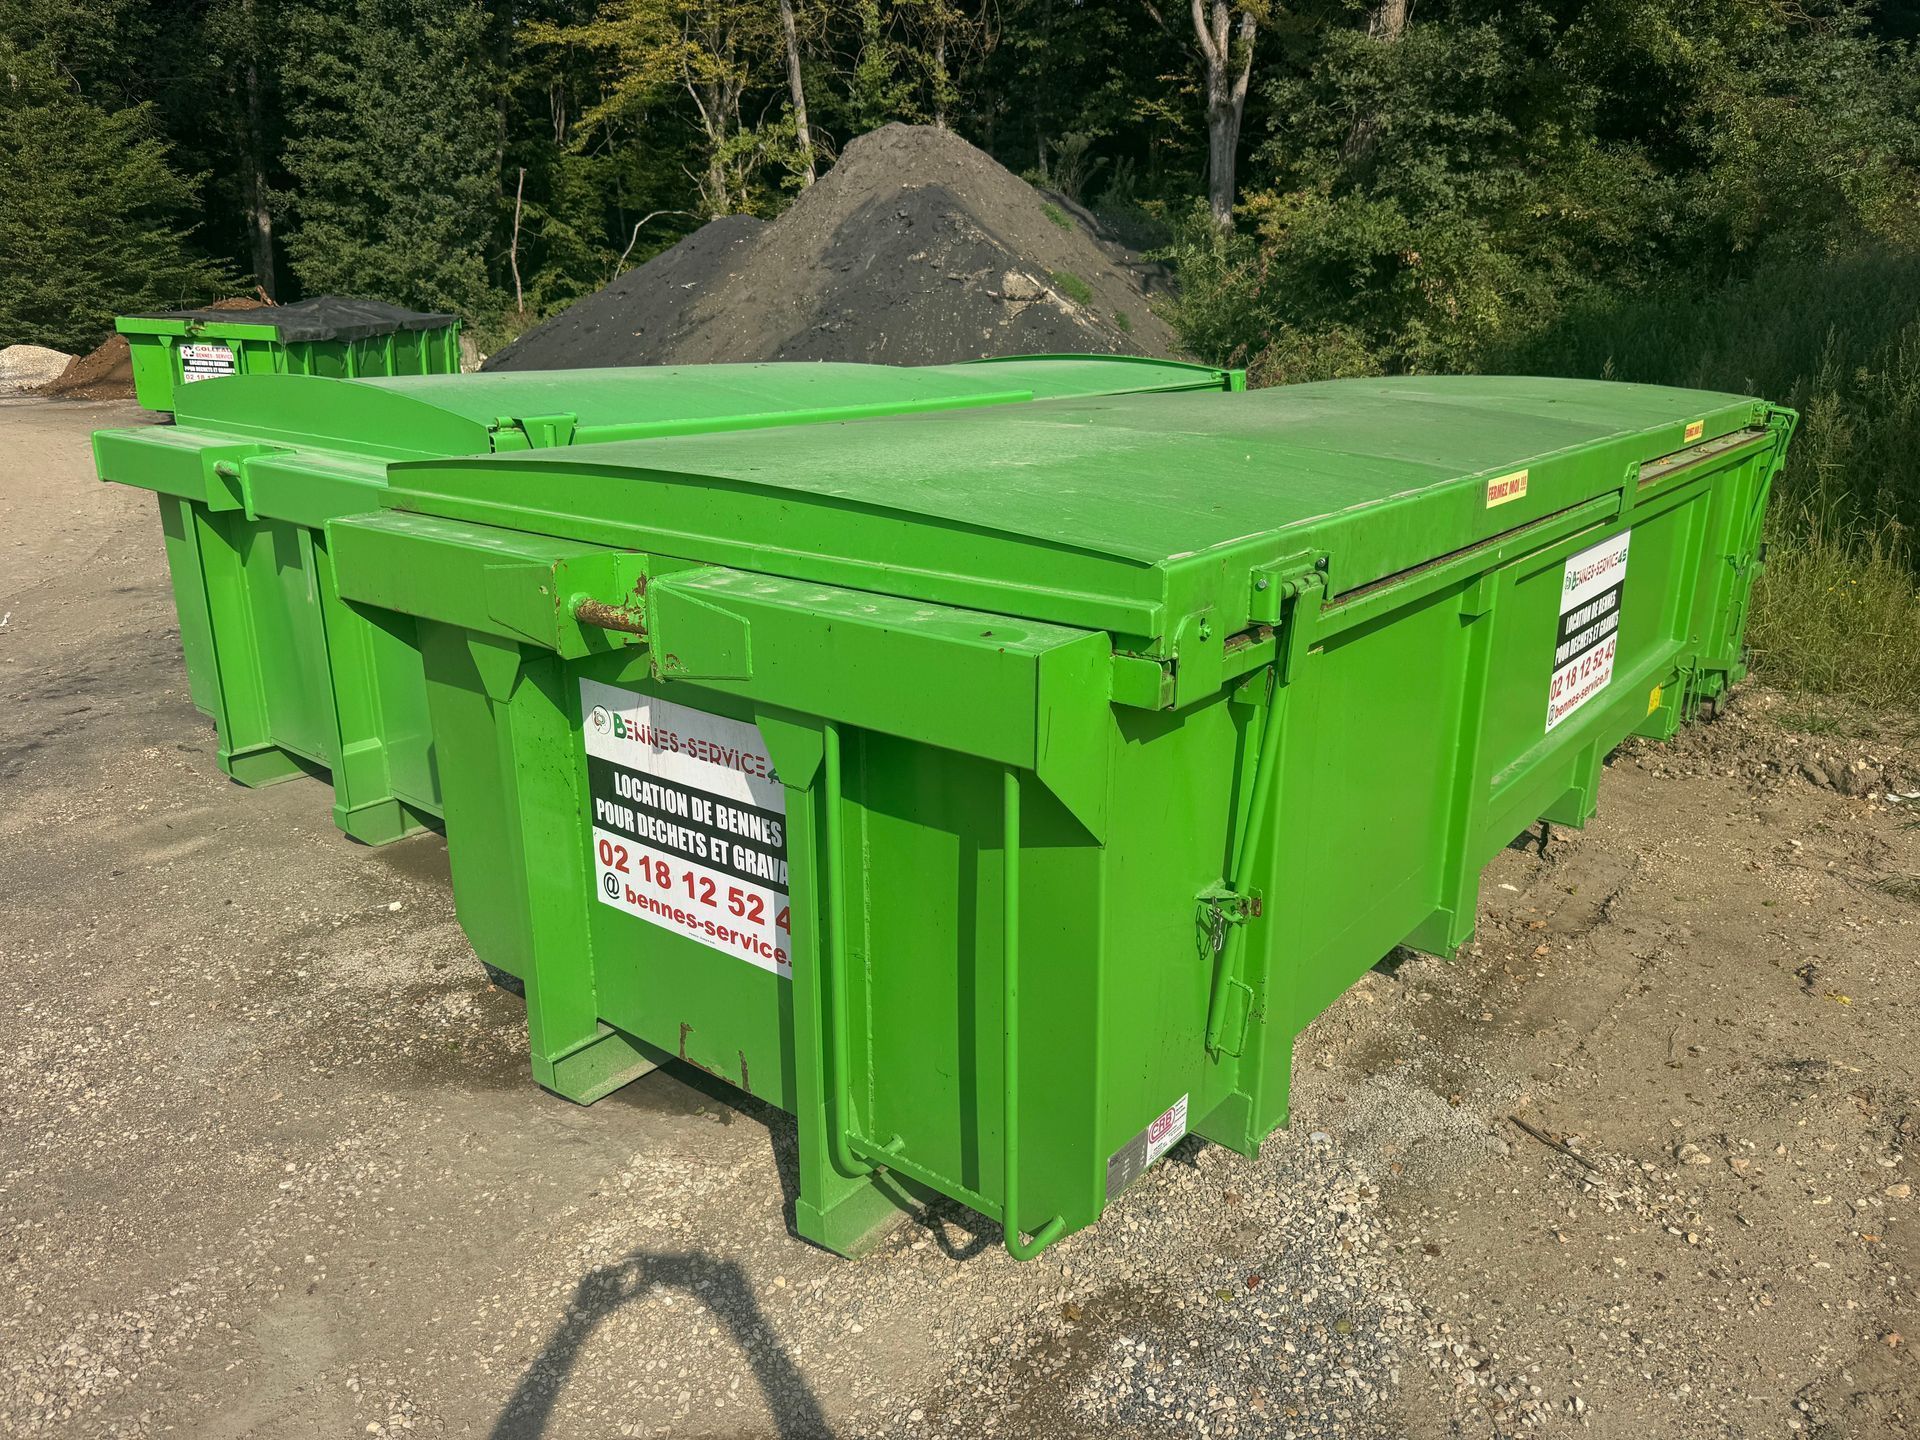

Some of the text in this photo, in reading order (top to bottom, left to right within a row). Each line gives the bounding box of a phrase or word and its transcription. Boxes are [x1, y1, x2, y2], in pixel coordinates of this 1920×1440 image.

[1488, 482, 1508, 501] FERMEZ
[1509, 478, 1520, 494] MOI
[1565, 605, 1592, 635] LOCATION
[1590, 600, 1599, 620] DE
[1550, 638, 1616, 702] 02 18 12 52 43
[1554, 641, 1570, 666] POUR
[596, 798, 635, 833] POUR
[636, 812, 707, 858] DECHETS
[710, 836, 730, 865] ET
[614, 772, 783, 848] LOCATION DE BENNES
[599, 838, 630, 874] 02
[638, 854, 672, 890] 18
[682, 870, 718, 908] 12
[728, 886, 766, 926] 52
[1152, 1112, 1172, 1134] CRB
